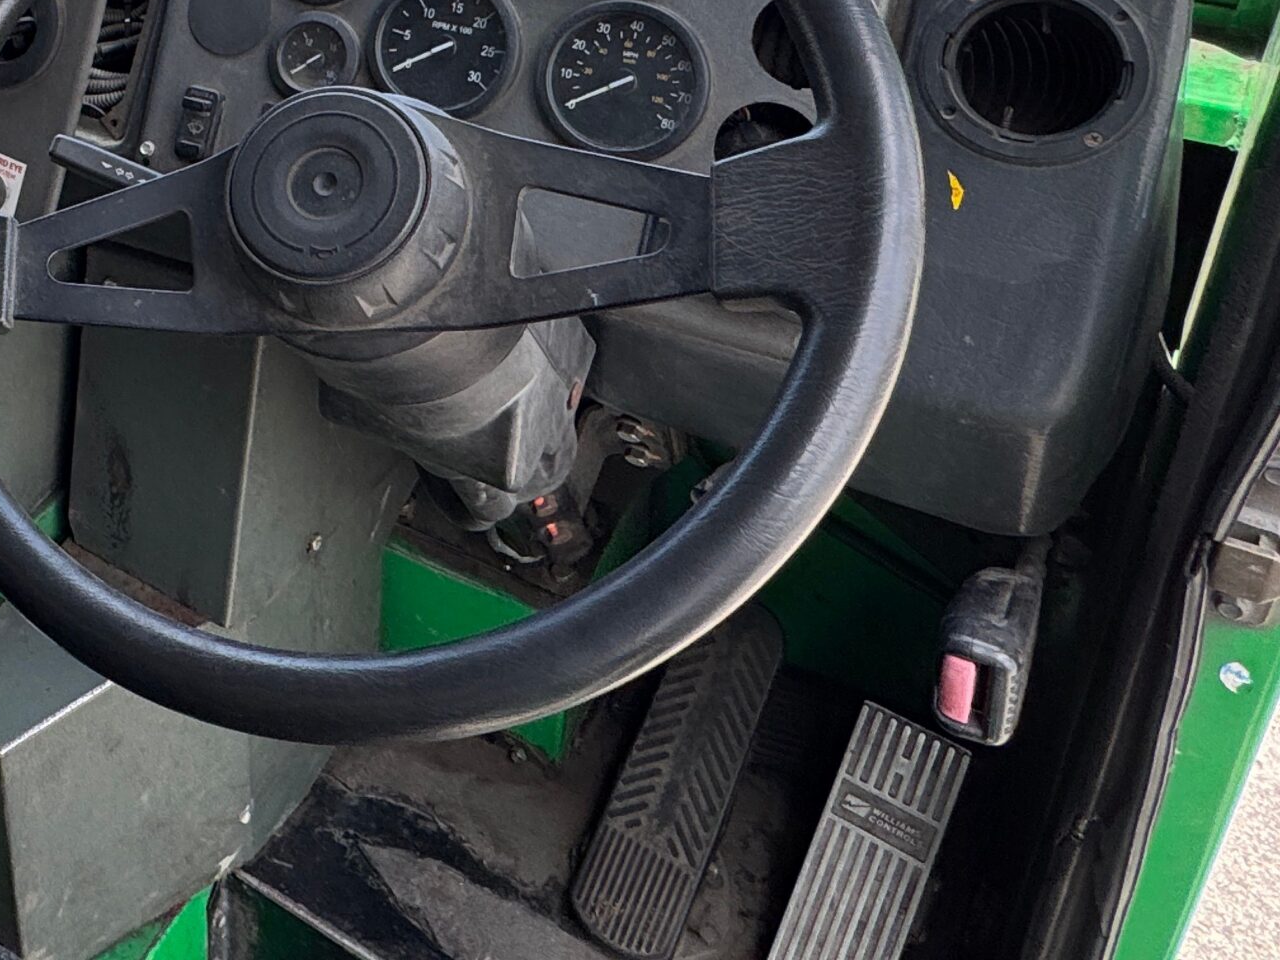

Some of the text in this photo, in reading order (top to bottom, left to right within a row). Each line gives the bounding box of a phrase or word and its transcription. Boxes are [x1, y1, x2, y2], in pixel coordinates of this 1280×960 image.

[423, 7, 435, 19] 10
[451, 2, 464, 14] 15
[432, 20, 450, 31] RPM
[459, 26, 473, 35] 100
[473, 17, 487, 29] 20
[596, 22, 611, 34] 30
[630, 20, 644, 32] 40
[403, 29, 412, 41] 5
[662, 35, 675, 47] 50
[572, 39, 586, 51] 20
[480, 45, 495, 58] 25
[623, 51, 639, 59] MPH
[678, 62, 691, 72] 60
[467, 70, 482, 83] 30
[561, 68, 573, 79] 10
[677, 93, 691, 104] 70
[660, 119, 675, 130] 80
[9, 161, 24, 174] EYE
